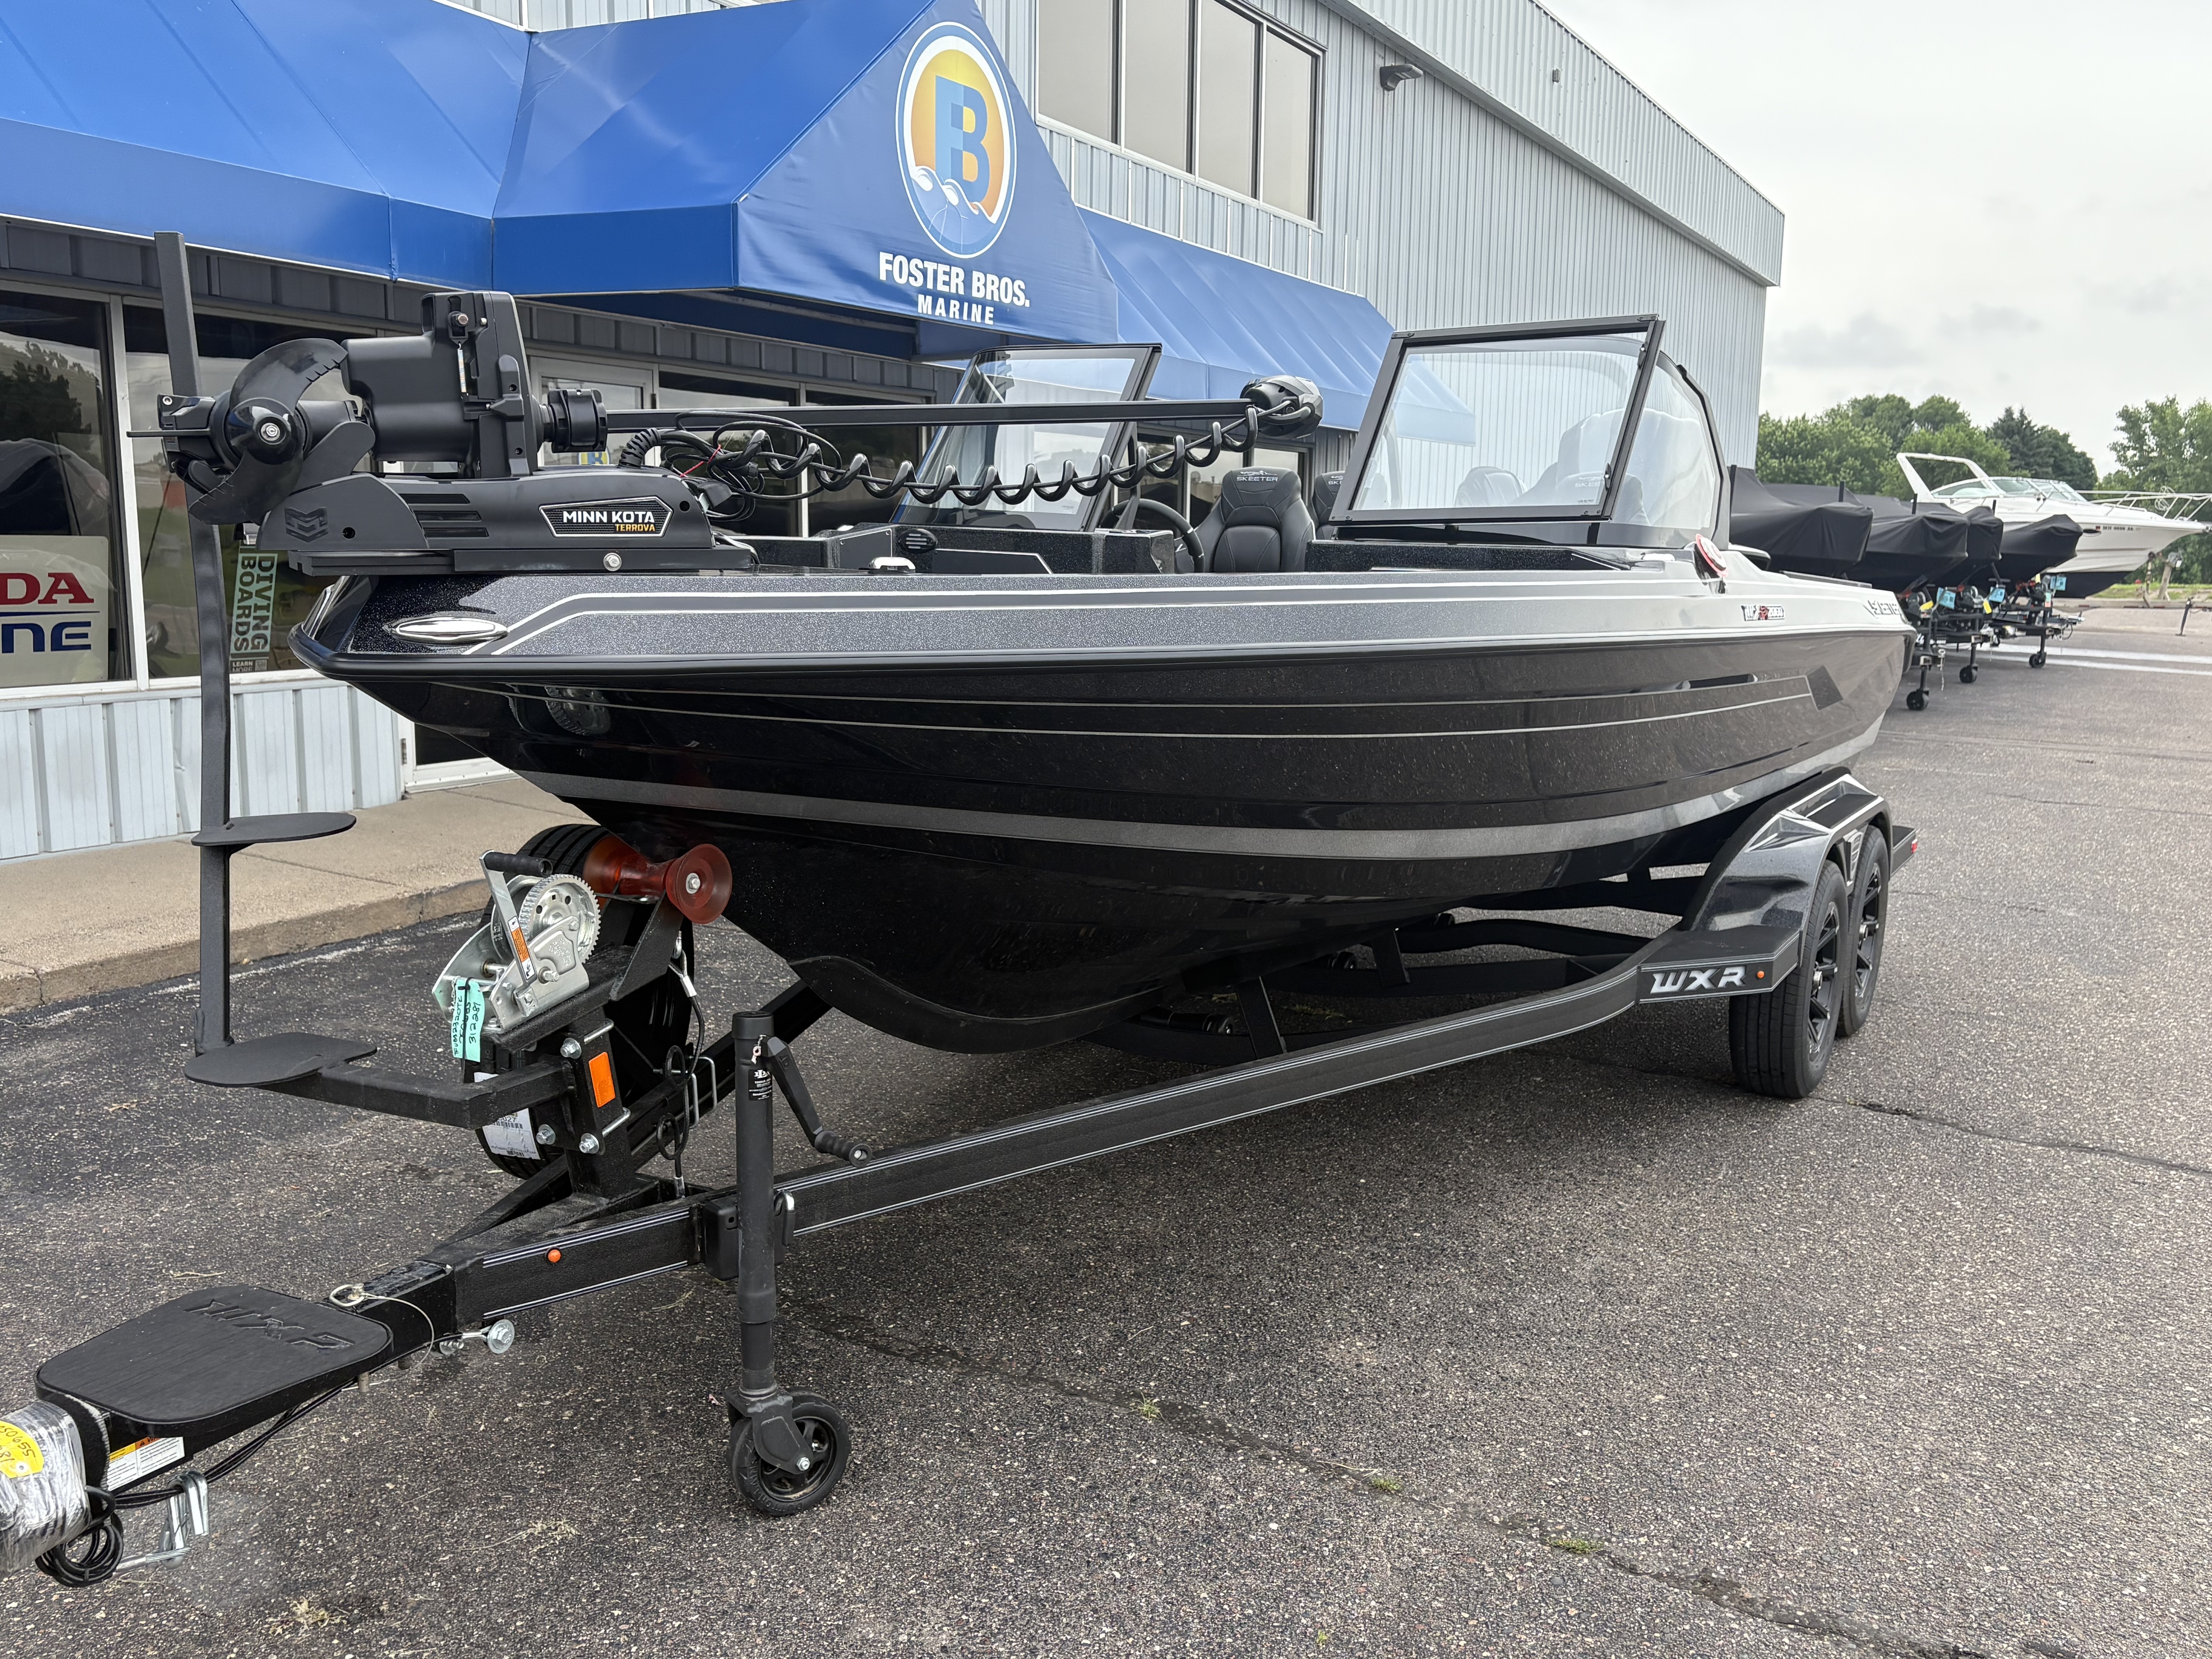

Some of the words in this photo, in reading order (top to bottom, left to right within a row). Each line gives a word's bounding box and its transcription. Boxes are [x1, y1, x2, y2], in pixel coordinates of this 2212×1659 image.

[879, 251, 965, 295] FOSTER
[972, 270, 1030, 307] BROS.
[917, 294, 994, 325] MARINE
[563, 511, 607, 523] MINN
[611, 511, 655, 523] KOTA
[615, 524, 656, 532] TERROVA
[234, 556, 257, 652] BOARDS
[251, 556, 275, 650] DIVING
[1650, 965, 1747, 994] WXR
